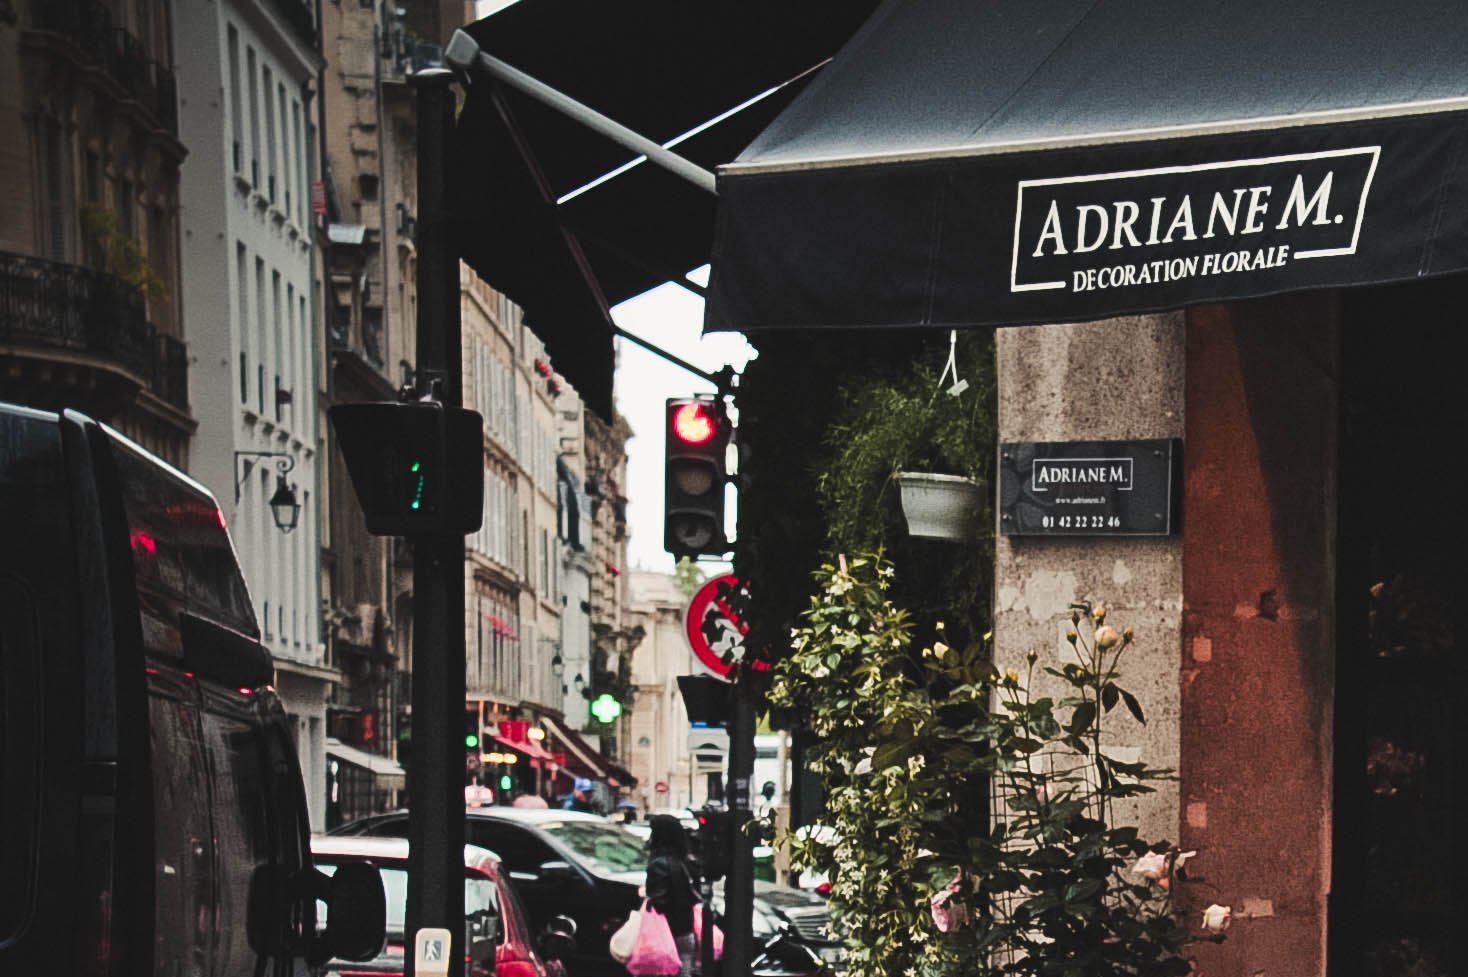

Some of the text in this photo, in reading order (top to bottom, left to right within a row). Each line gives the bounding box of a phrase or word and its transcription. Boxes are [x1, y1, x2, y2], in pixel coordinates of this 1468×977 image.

[1032, 171, 1344, 257] ADRIANE M.
[1073, 245, 1291, 293] DECORATION FLORALE
[1038, 465, 1129, 483] ADRIANE M.
[1042, 515, 1120, 528] 01 42 22 22 46
